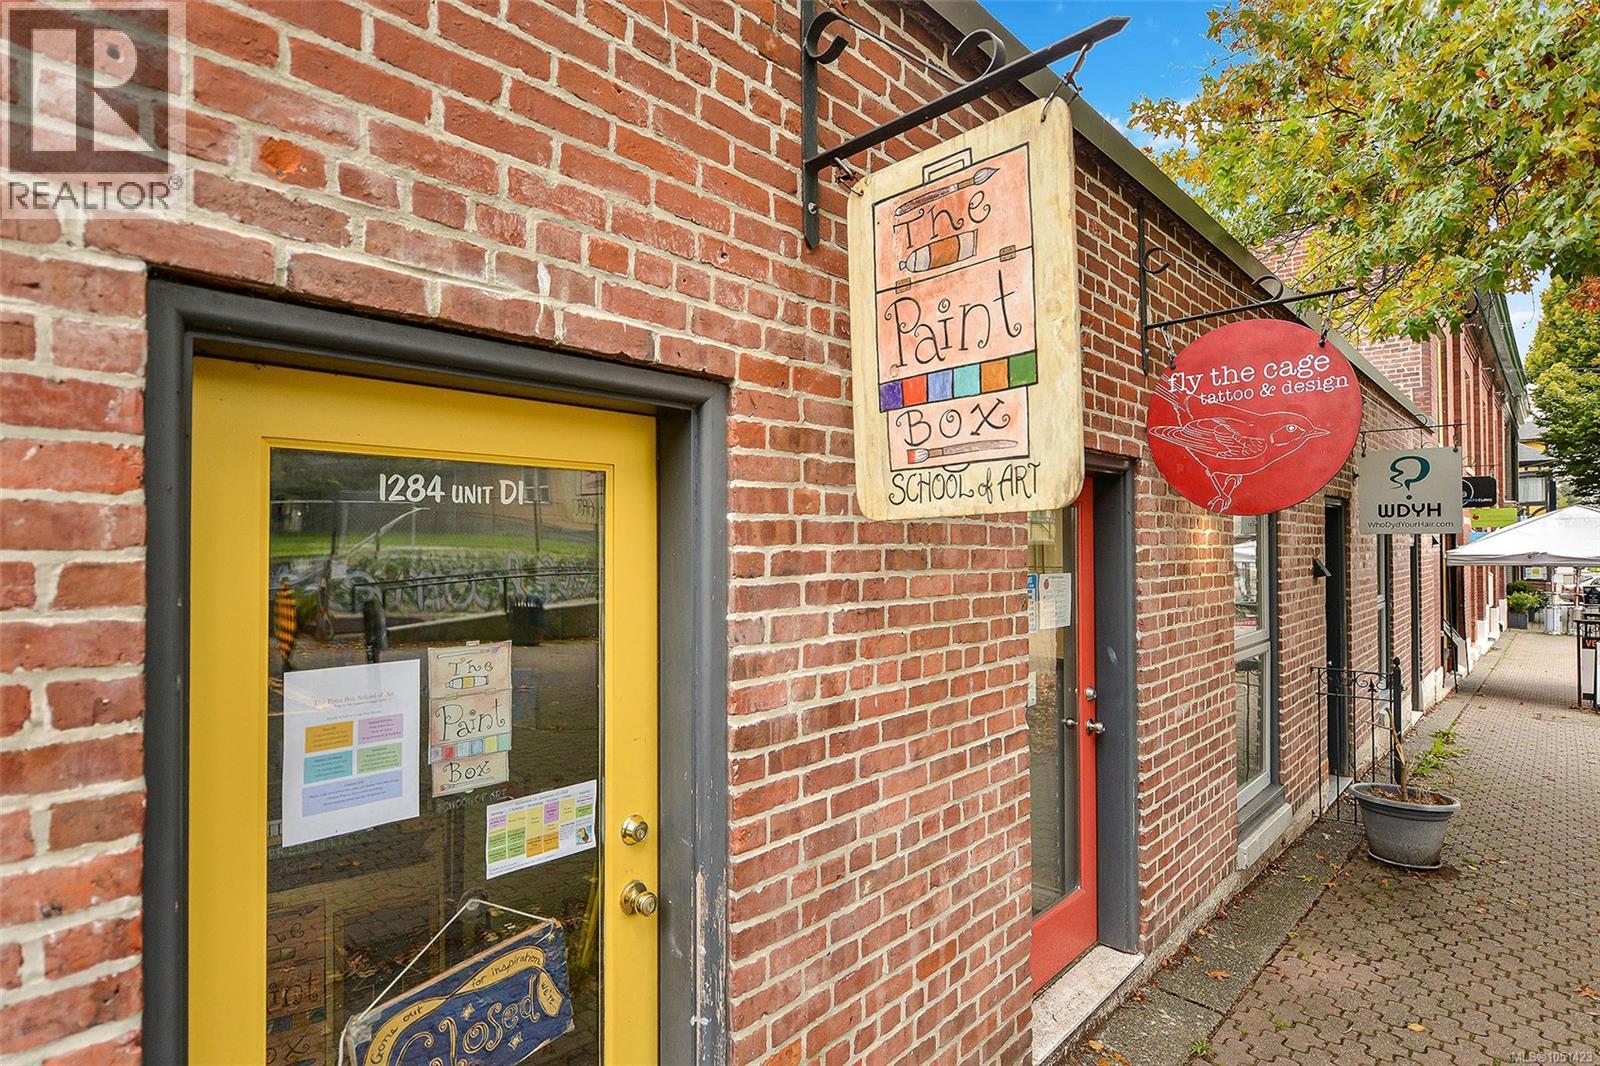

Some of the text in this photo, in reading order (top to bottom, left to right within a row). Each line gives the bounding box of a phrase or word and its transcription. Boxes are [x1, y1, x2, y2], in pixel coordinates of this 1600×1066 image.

[893, 190, 991, 249] The
[884, 269, 1022, 370] Paint
[1167, 352, 1331, 395] fly the cage
[1200, 374, 1350, 406] tattoo & design
[379, 473, 446, 503] 1284
[451, 483, 494, 504] UNIT
[888, 462, 1041, 505] SCHOOL of ART
[1367, 520, 1454, 530] WhoDydYourHair.com
[1377, 503, 1442, 518] WDYH
[448, 657, 494, 676] The
[435, 698, 505, 742] Paint
[370, 951, 543, 1065] Gone out for inspiration
